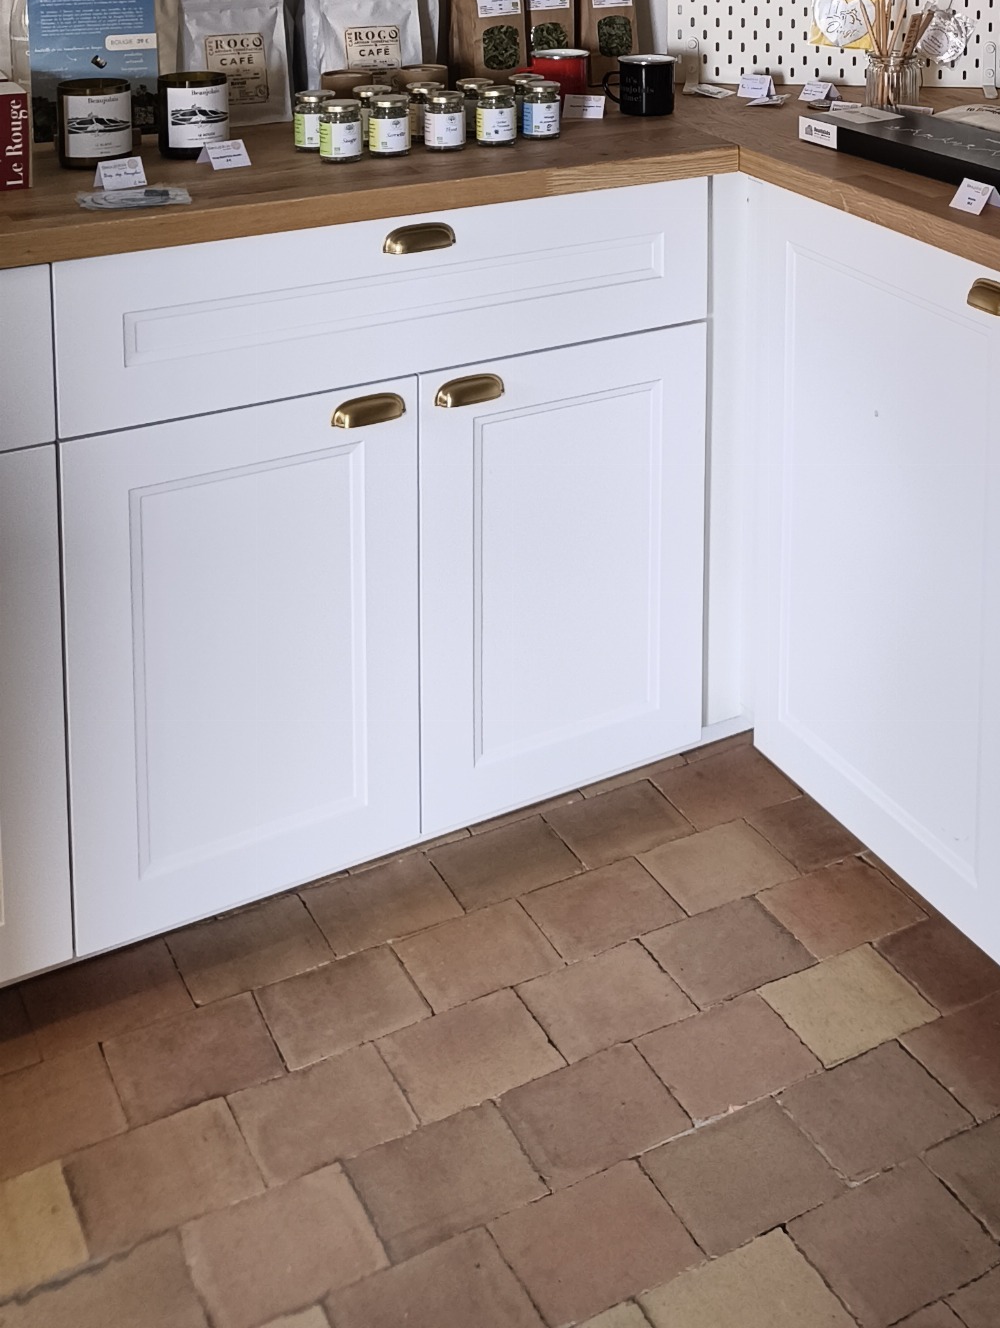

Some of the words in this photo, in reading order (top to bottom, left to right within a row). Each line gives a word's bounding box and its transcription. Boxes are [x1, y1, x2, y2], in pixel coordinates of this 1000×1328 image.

[354, 30, 398, 41] ROGO
[215, 37, 262, 49] ROGO
[359, 46, 390, 57] CAFÉ
[220, 54, 254, 66] CAFÉ
[5, 99, 28, 156] Rouge
[6, 162, 24, 186] Le
